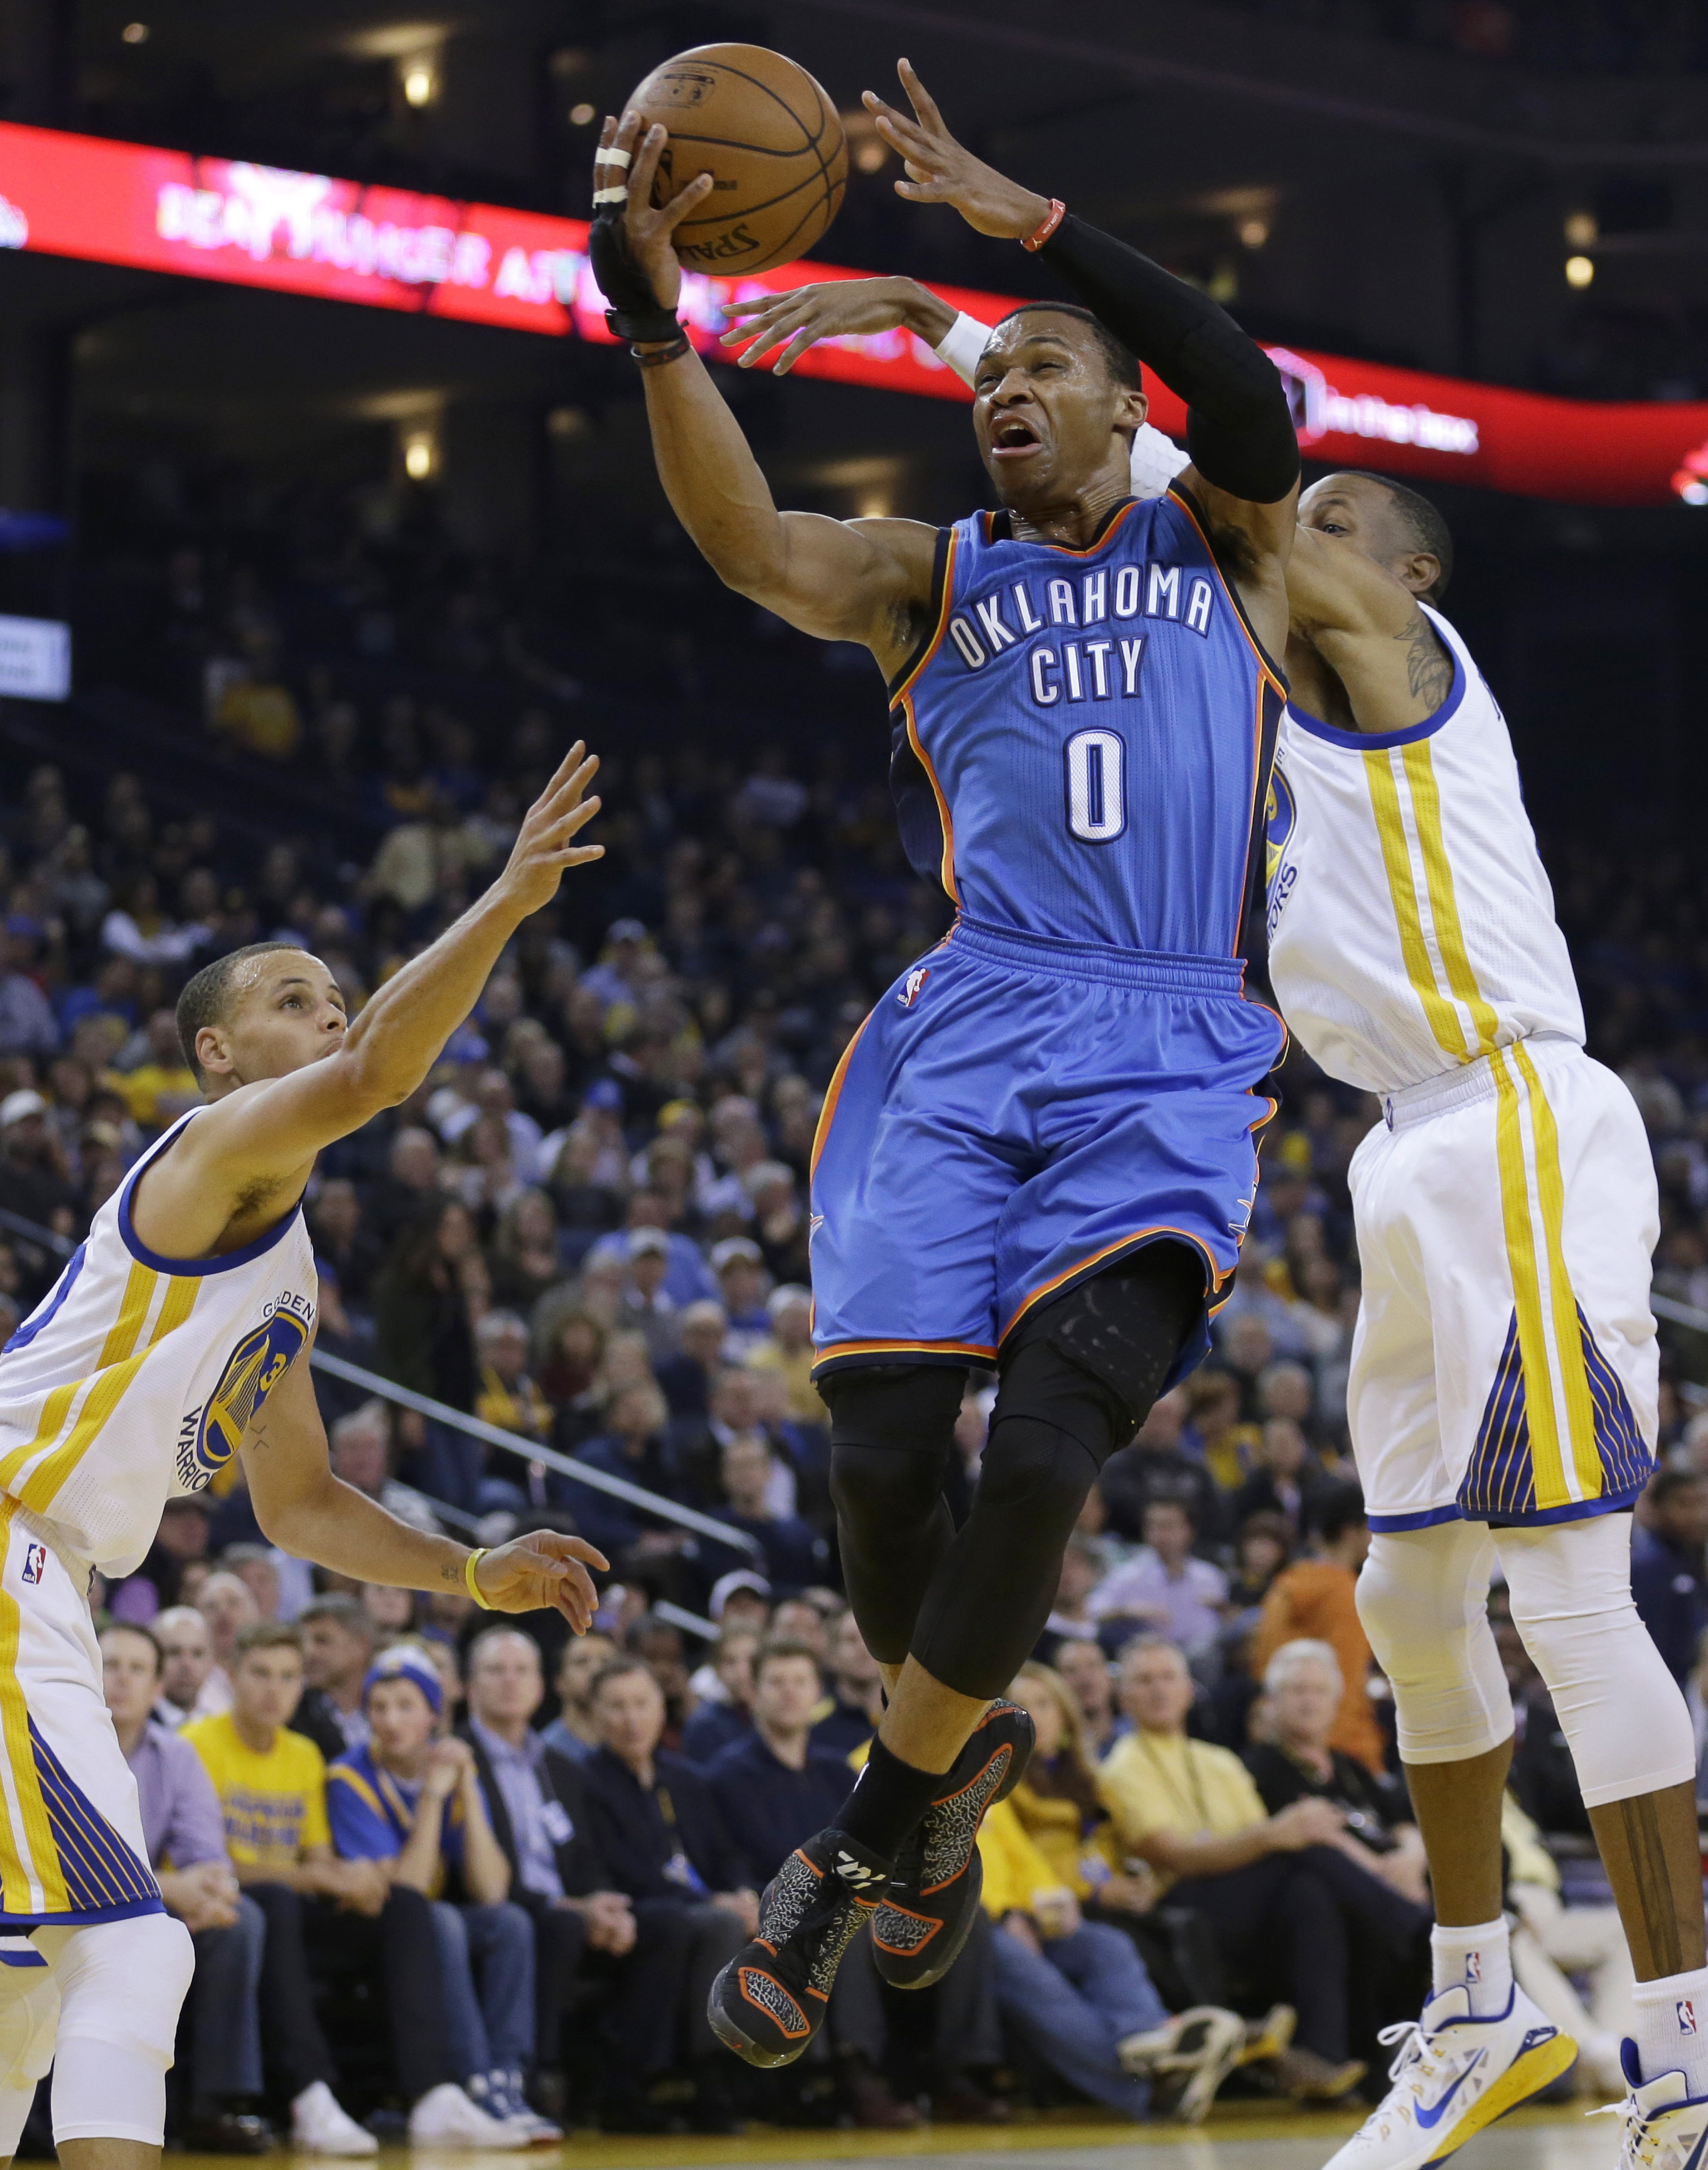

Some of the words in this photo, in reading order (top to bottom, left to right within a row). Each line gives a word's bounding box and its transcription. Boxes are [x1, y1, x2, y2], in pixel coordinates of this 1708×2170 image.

[674, 223, 761, 262] SPAL
[950, 561, 1213, 671] OKLAHOMA
[1029, 635, 1147, 707] CITY
[1065, 728, 1127, 845] 0
[898, 994, 908, 1004] NBA
[260, 1352, 289, 1391] 3
[176, 1405, 214, 1491] WARRIO
